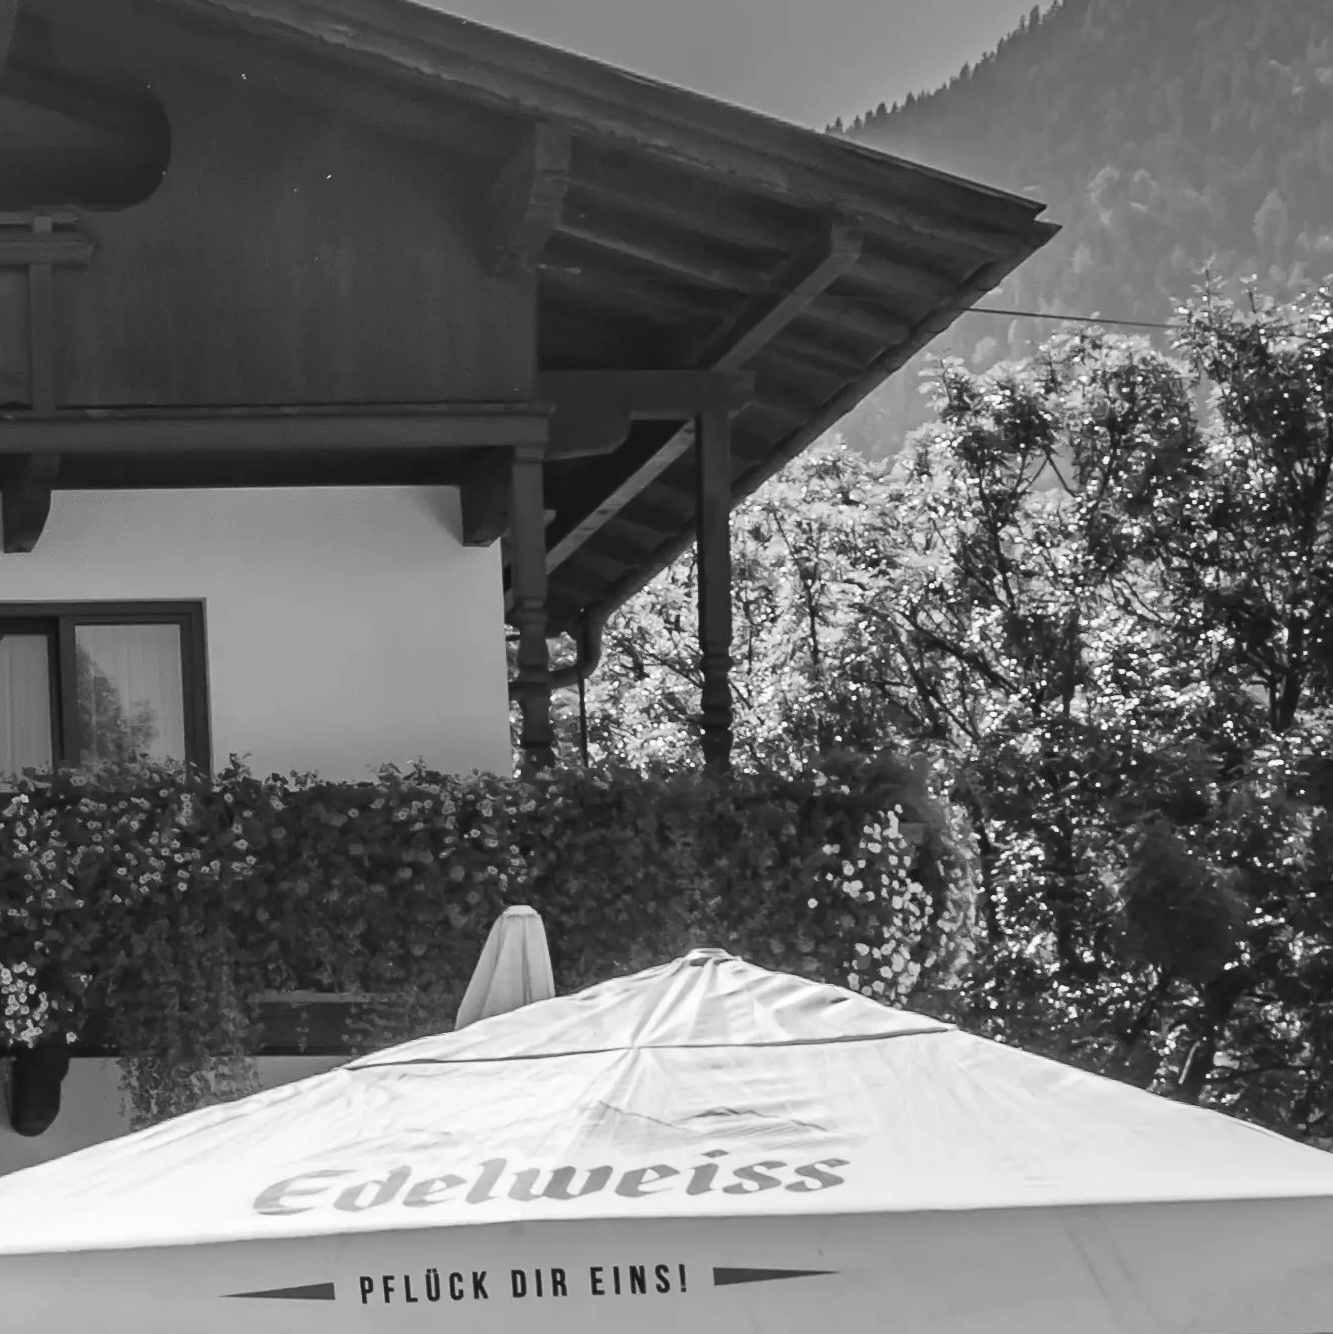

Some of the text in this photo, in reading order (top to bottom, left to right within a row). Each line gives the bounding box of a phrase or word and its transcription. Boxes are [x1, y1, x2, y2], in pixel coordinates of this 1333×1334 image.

[251, 1149, 850, 1216] Edelweiss
[359, 1264, 688, 1304] PFLÜCK DIR EINS!
